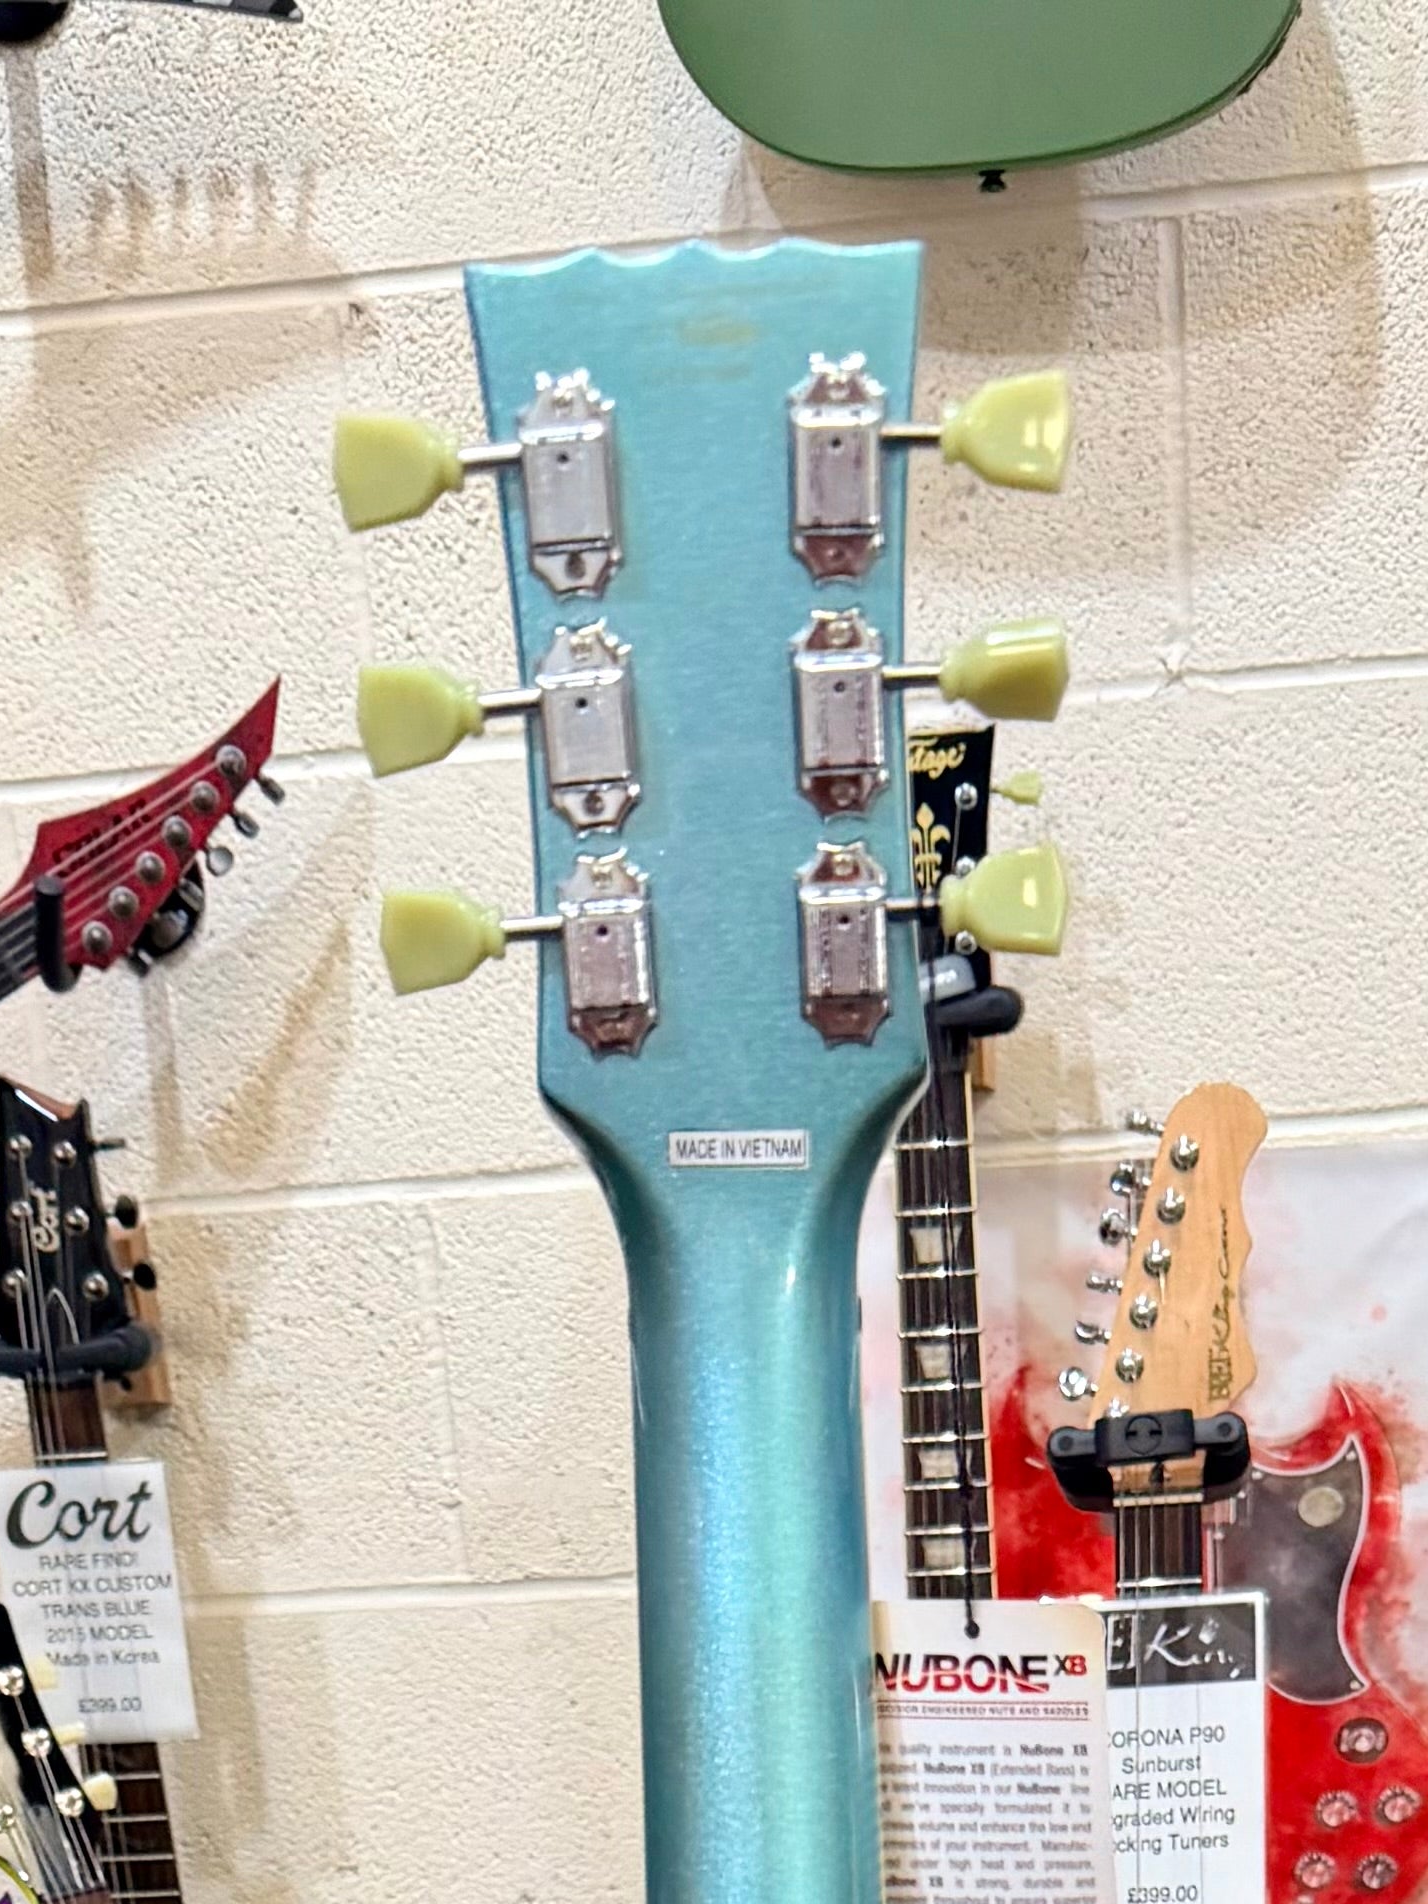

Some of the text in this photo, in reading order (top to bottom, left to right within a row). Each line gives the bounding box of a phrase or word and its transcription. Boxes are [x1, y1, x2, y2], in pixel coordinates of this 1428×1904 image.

[676, 1138, 802, 1158] MADE IN VIETNAM
[6, 1480, 153, 1550] Cort
[13, 1579, 61, 1597] CORT
[96, 1574, 172, 1593] CUSTOM
[40, 1600, 152, 1619] TRANS BLUE
[90, 1624, 153, 1641] MODEL
[46, 1650, 160, 1666] Made in Korea
[874, 1652, 1087, 1693] NUBONE XB
[1189, 1726, 1226, 1745] P90
[1122, 1755, 1201, 1775] Sunburst
[1112, 1779, 1227, 1800] ARE MODEL
[1112, 1805, 1235, 1831] graded Wiring
[1114, 1833, 1229, 1855] cking Tuners
[1127, 1885, 1198, 1904] £399.00
